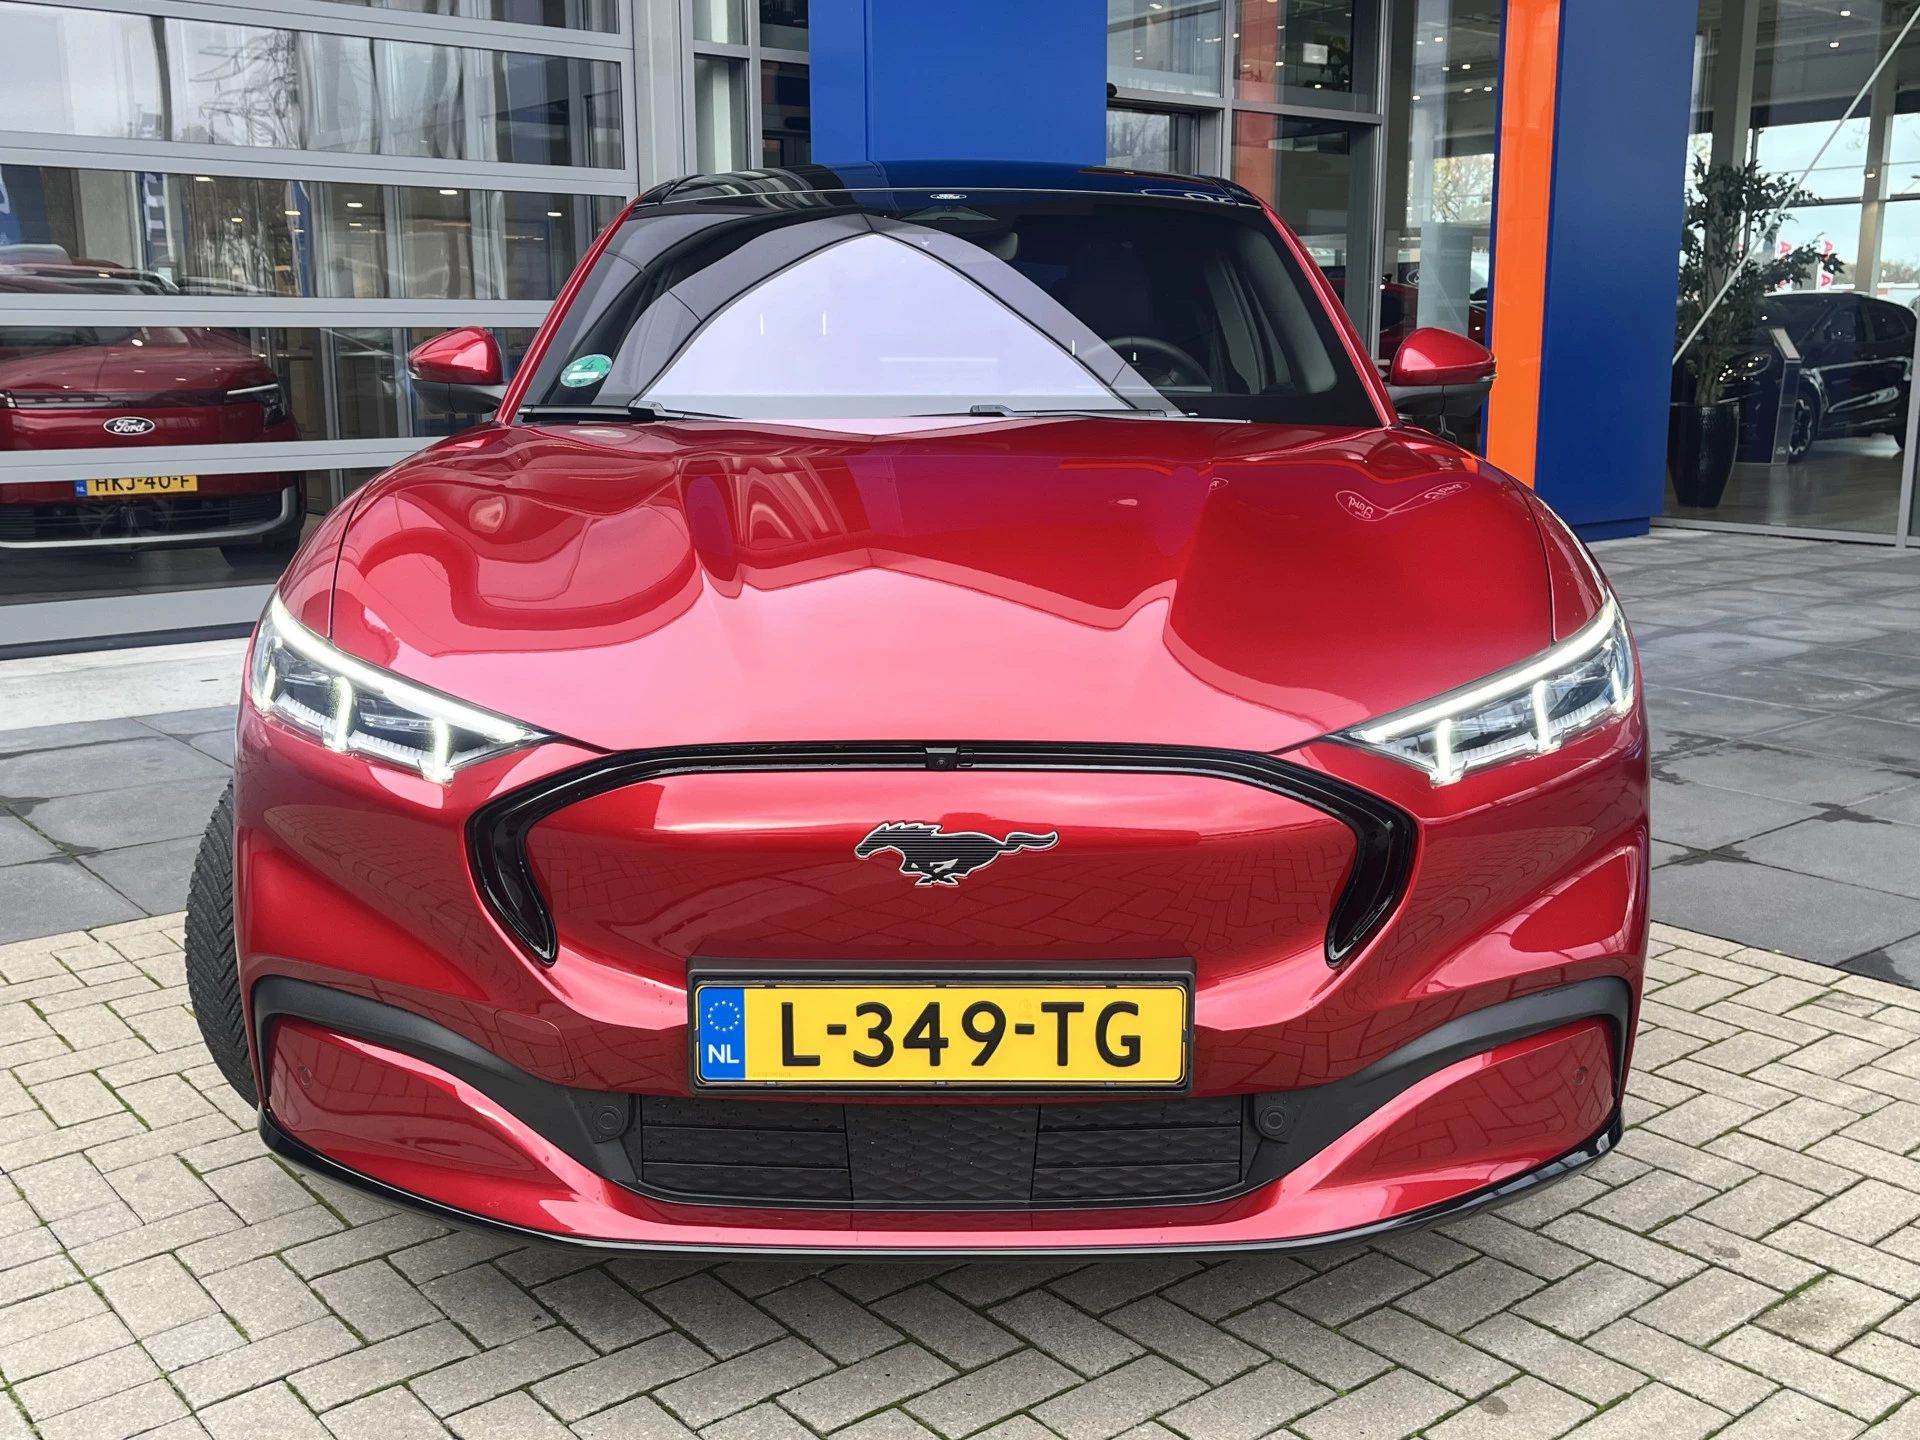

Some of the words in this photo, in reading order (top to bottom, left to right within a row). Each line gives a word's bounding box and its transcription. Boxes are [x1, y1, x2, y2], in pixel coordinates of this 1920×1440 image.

[114, 419, 145, 433] Ford
[708, 1044, 740, 1064] NL
[781, 1001, 1142, 1067] L-349-TG
